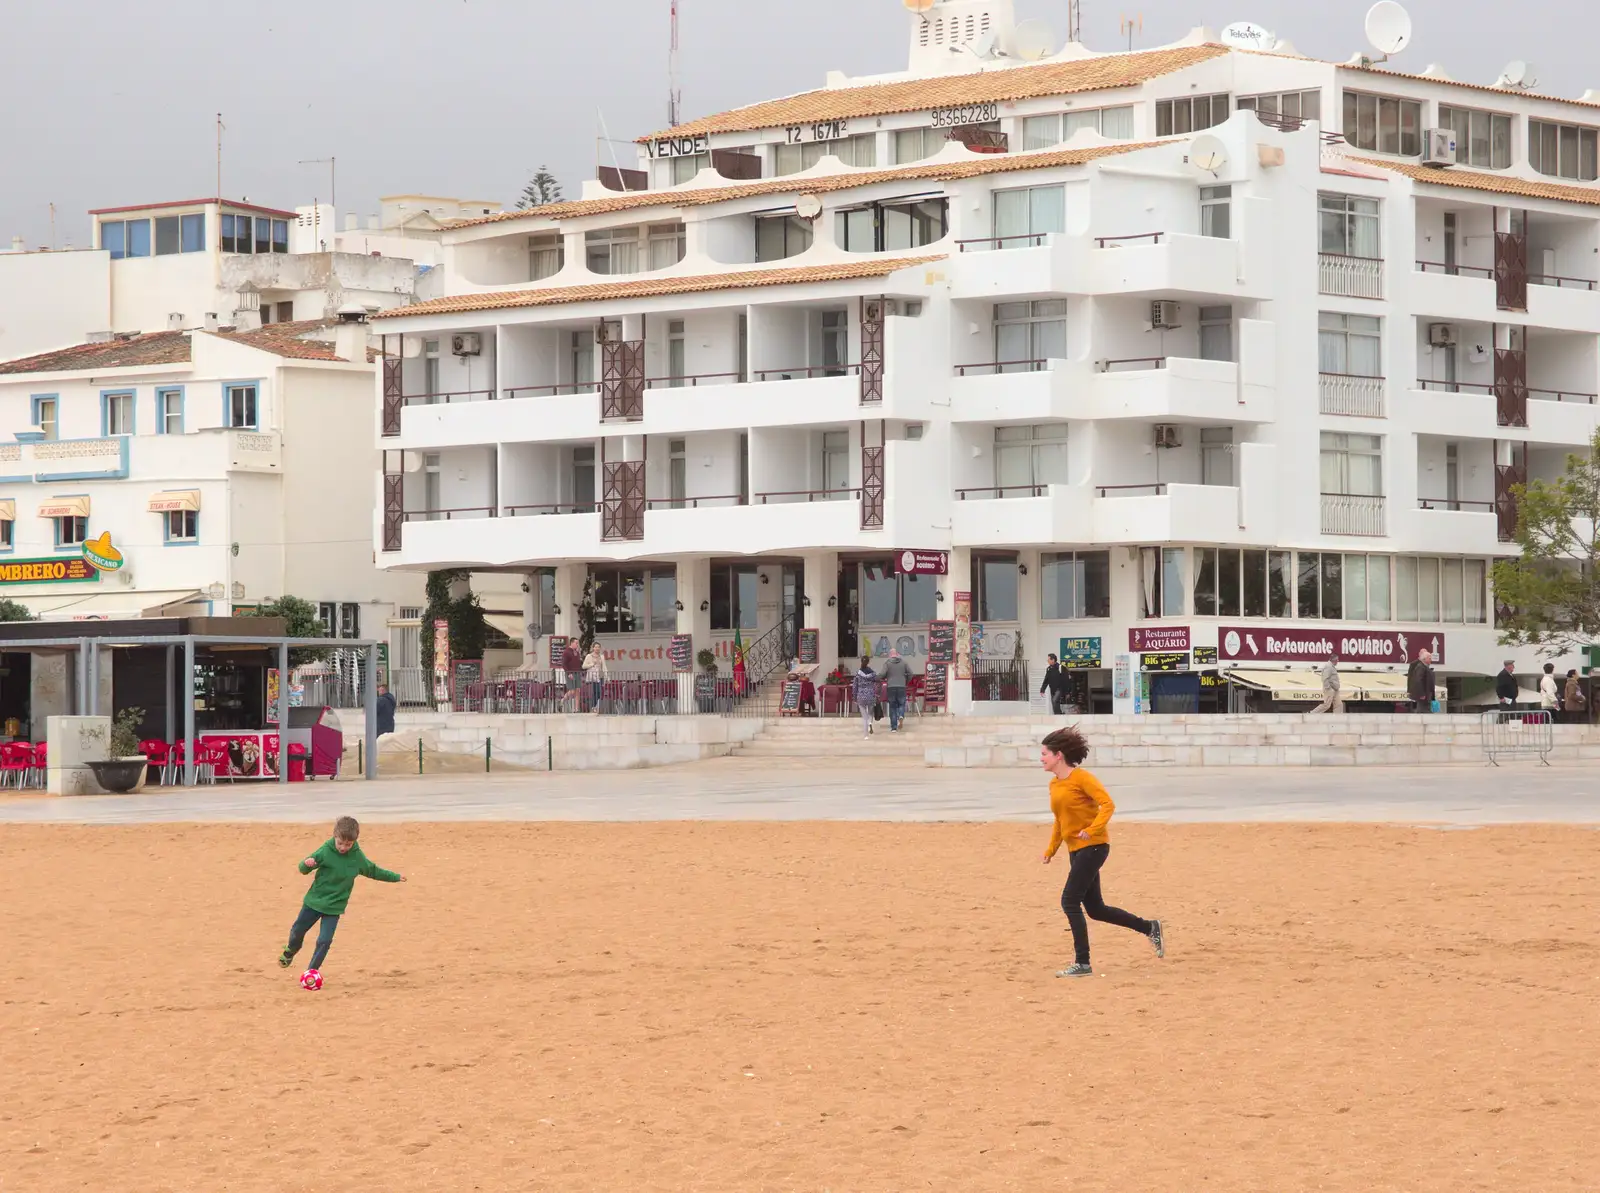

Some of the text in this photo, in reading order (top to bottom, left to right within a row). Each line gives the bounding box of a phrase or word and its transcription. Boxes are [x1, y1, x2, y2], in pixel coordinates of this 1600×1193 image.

[931, 104, 998, 128] 963662280
[785, 126, 802, 144] T2
[645, 137, 706, 159] VENDE
[86, 550, 118, 567] MEXICANO
[1145, 629, 1186, 638] Restaurante
[1067, 639, 1090, 649] METZ
[1145, 638, 1187, 650] AQUÁRIO
[1266, 635, 1393, 656] Restaurante AQUÁRIO
[1144, 656, 1158, 665] BIG
[1201, 676, 1215, 686] BIG
